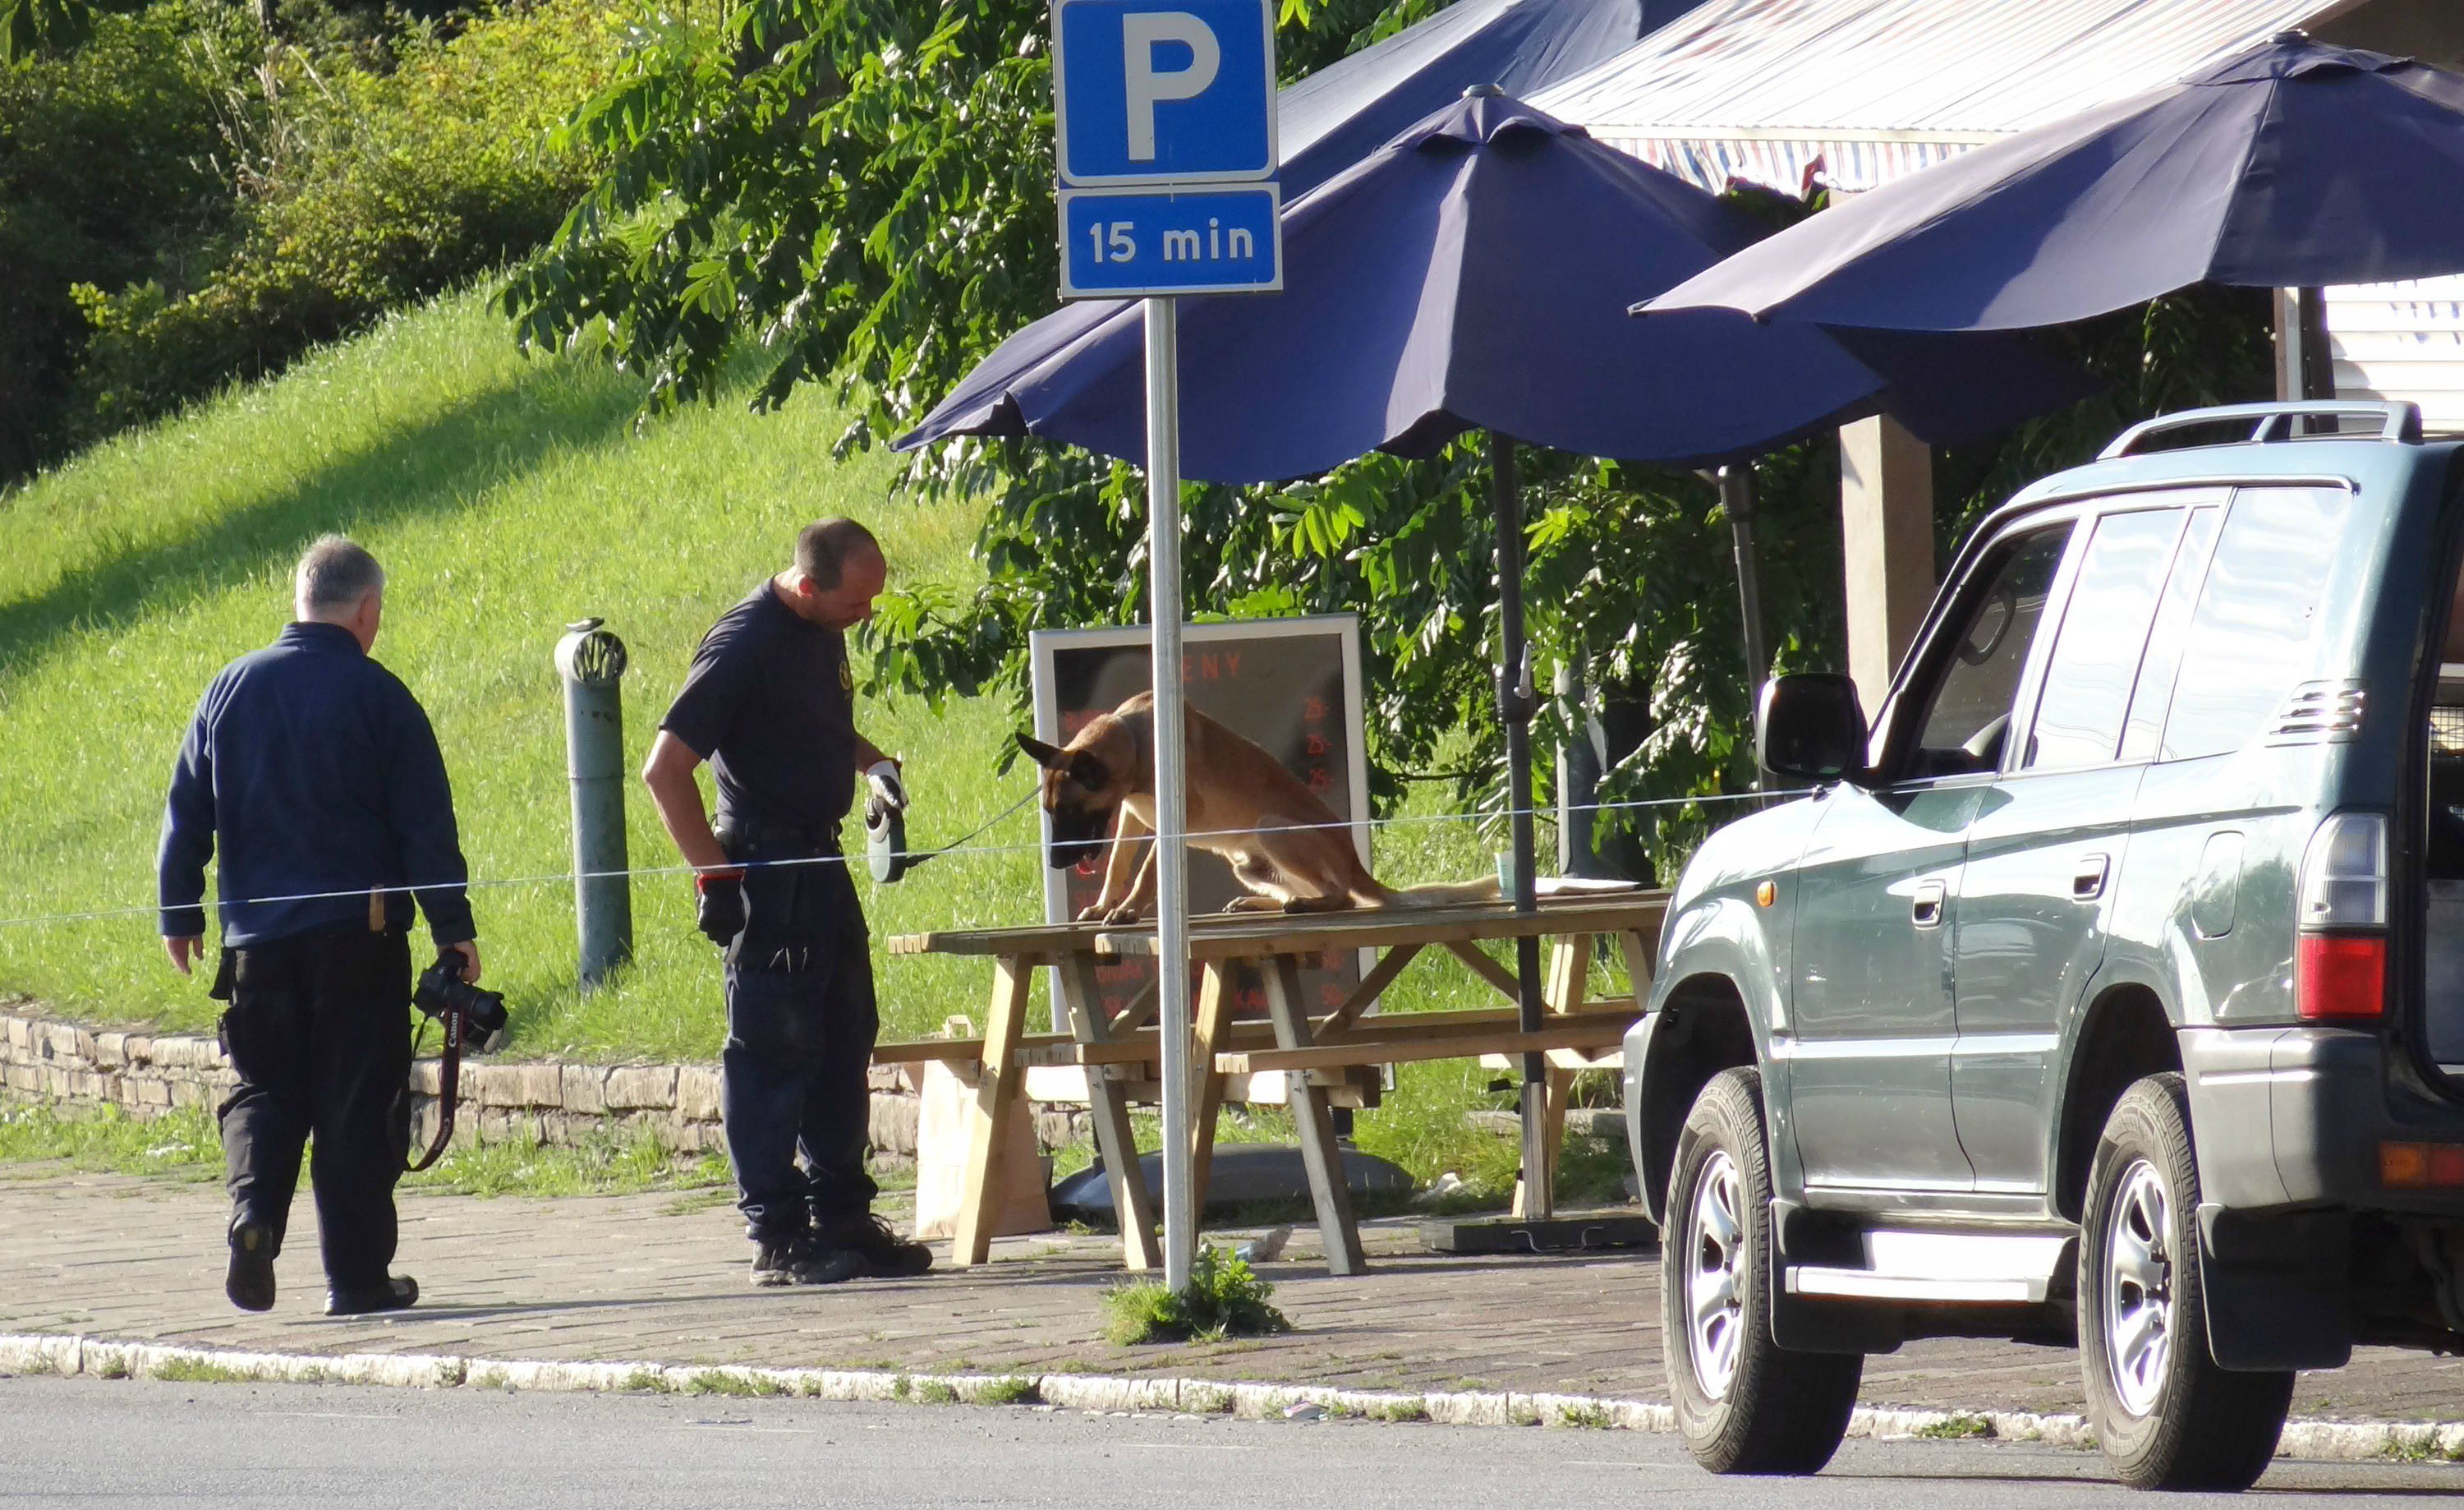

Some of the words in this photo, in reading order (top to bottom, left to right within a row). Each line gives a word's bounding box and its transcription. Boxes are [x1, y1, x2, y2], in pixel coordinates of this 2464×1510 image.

[1123, 12, 1221, 161] P
[1090, 221, 1136, 263] 15
[1163, 217, 1253, 261] min
[1182, 652, 1241, 683] ENY
[448, 1011, 459, 1047] Canon
